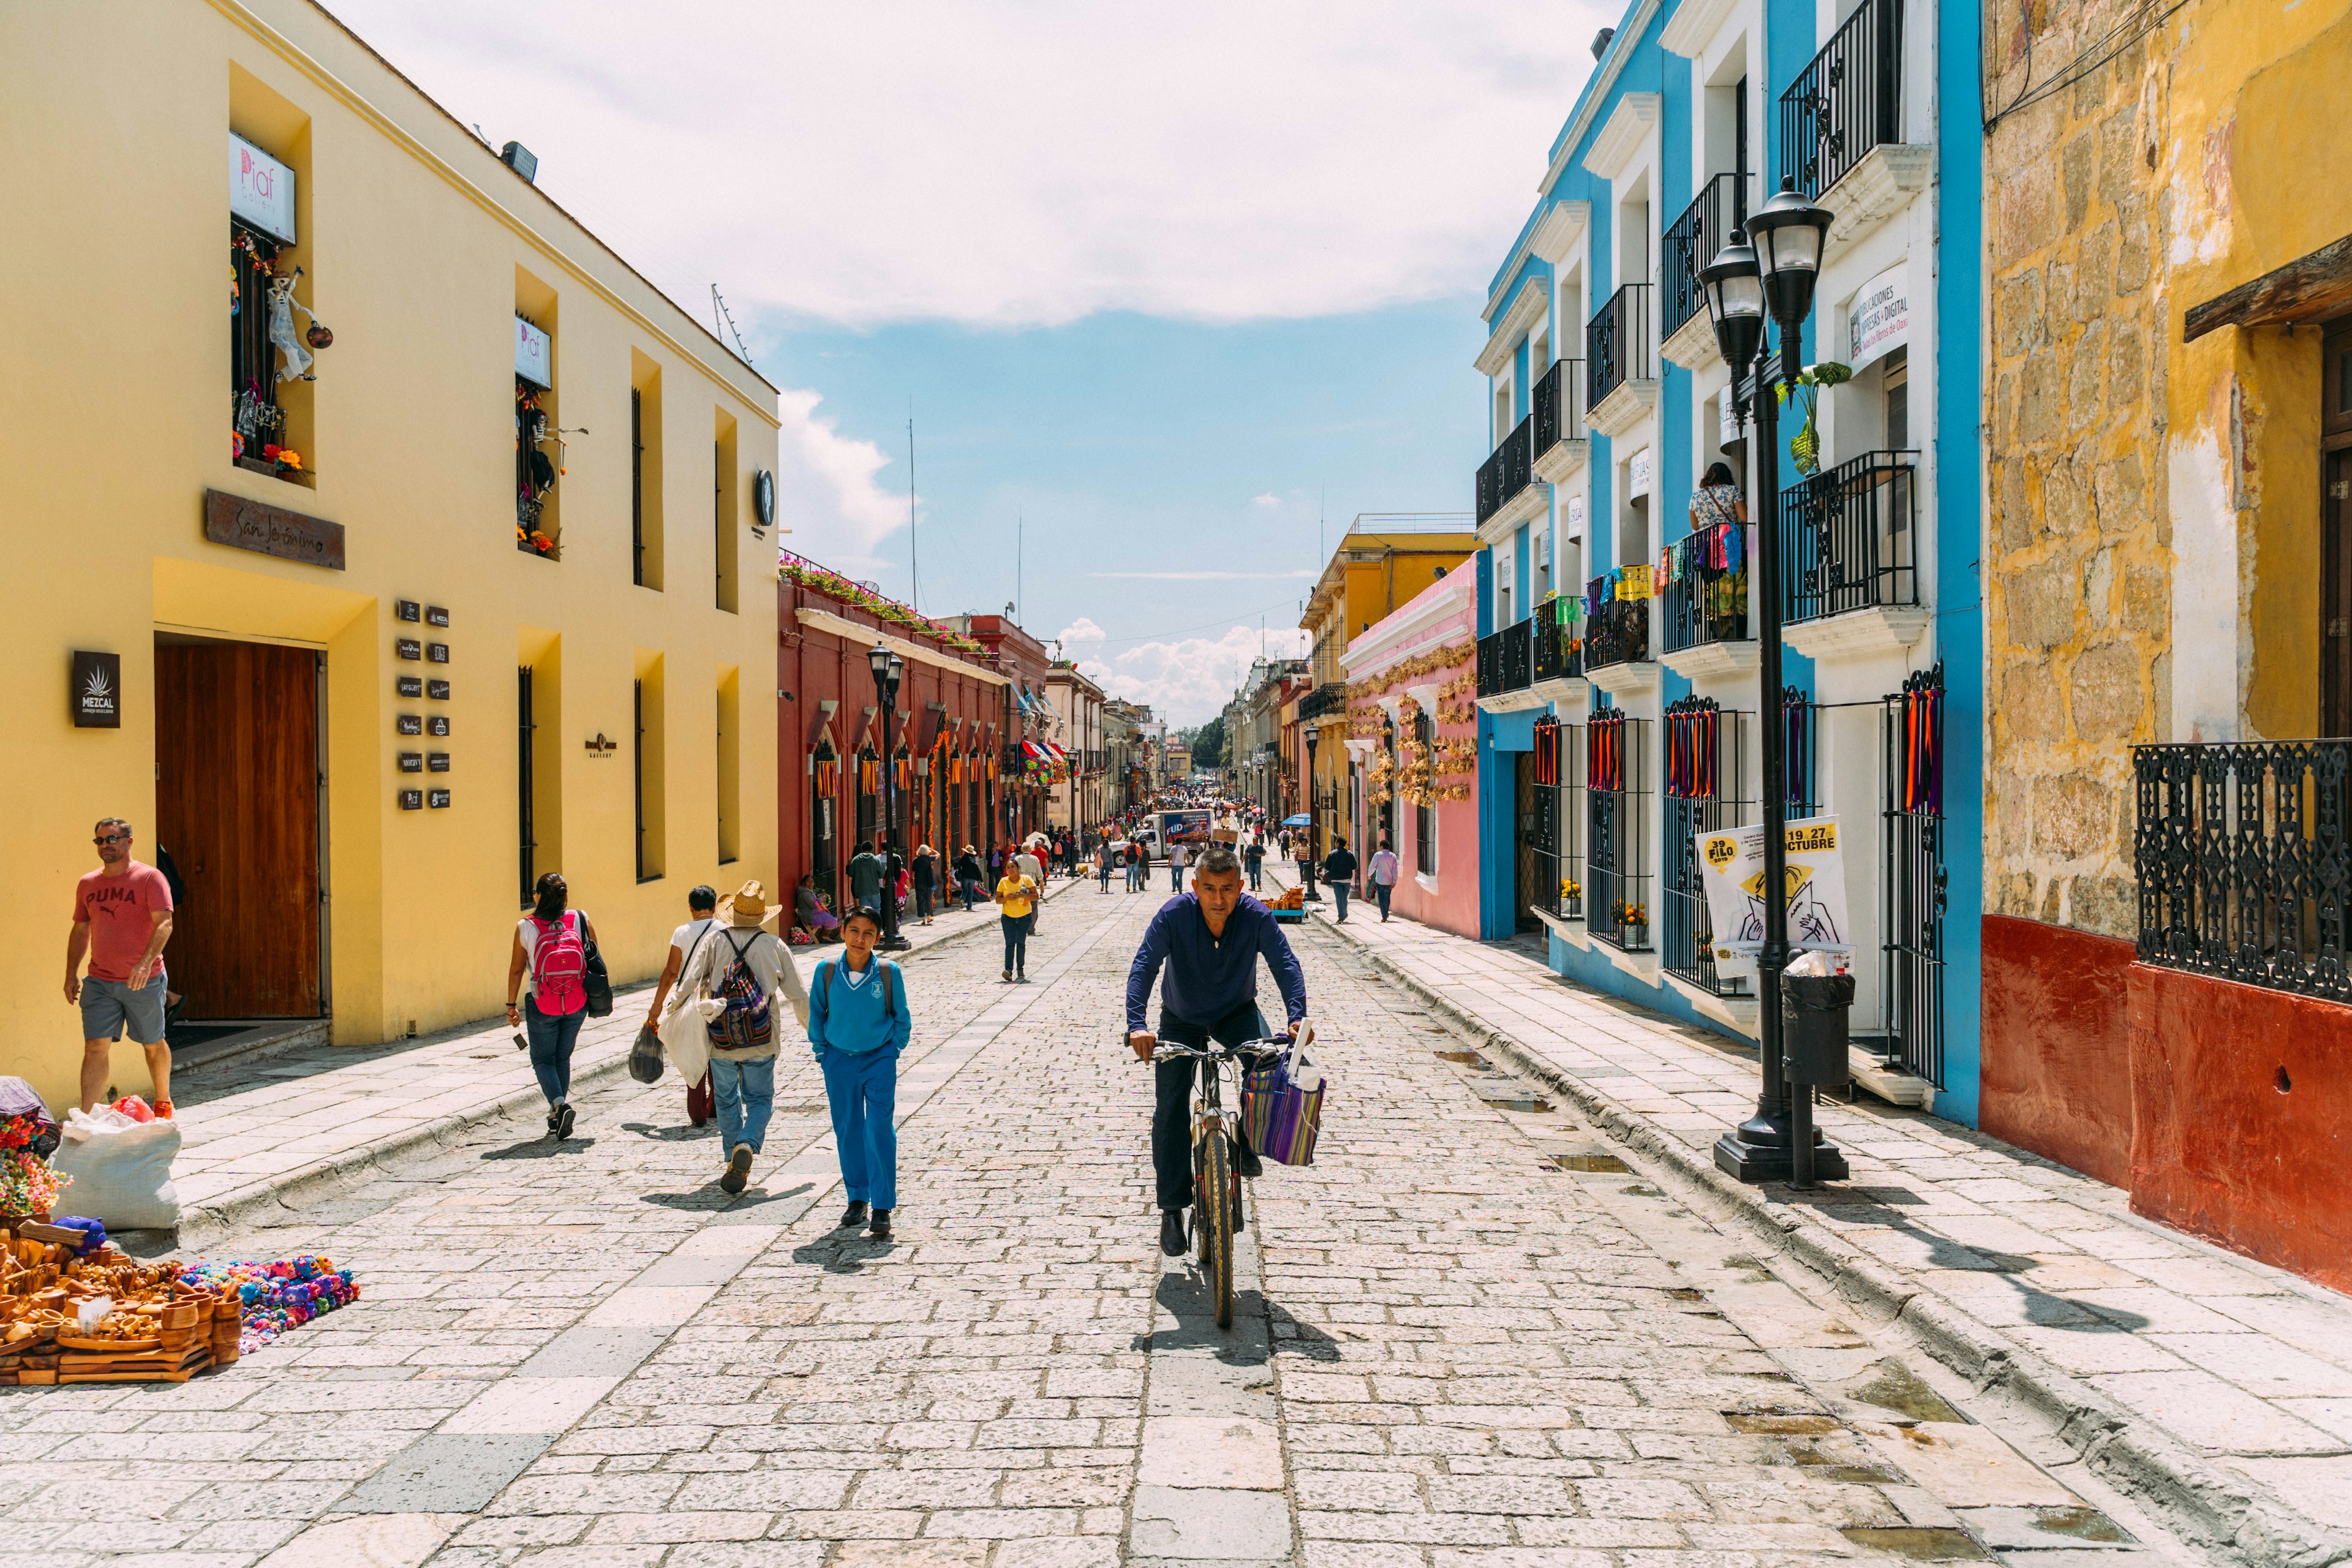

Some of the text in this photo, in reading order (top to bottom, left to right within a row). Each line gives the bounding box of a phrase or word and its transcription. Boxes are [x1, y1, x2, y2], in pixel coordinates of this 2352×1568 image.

[241, 148, 274, 200] Piaf
[1860, 285, 1894, 317] PUBLICACIONES
[1885, 296, 1908, 321] DIGITAL
[1889, 323, 1896, 334] de
[521, 323, 540, 358] Piaf
[236, 507, 263, 537] San
[82, 696, 114, 709] MEZCAL
[407, 792, 419, 805] Piaf
[1166, 823, 1183, 835] FUD
[1788, 831, 1803, 841] 19
[1811, 827, 1825, 839] 27
[1712, 840, 1725, 848] 39
[86, 887, 137, 907] PUMA
